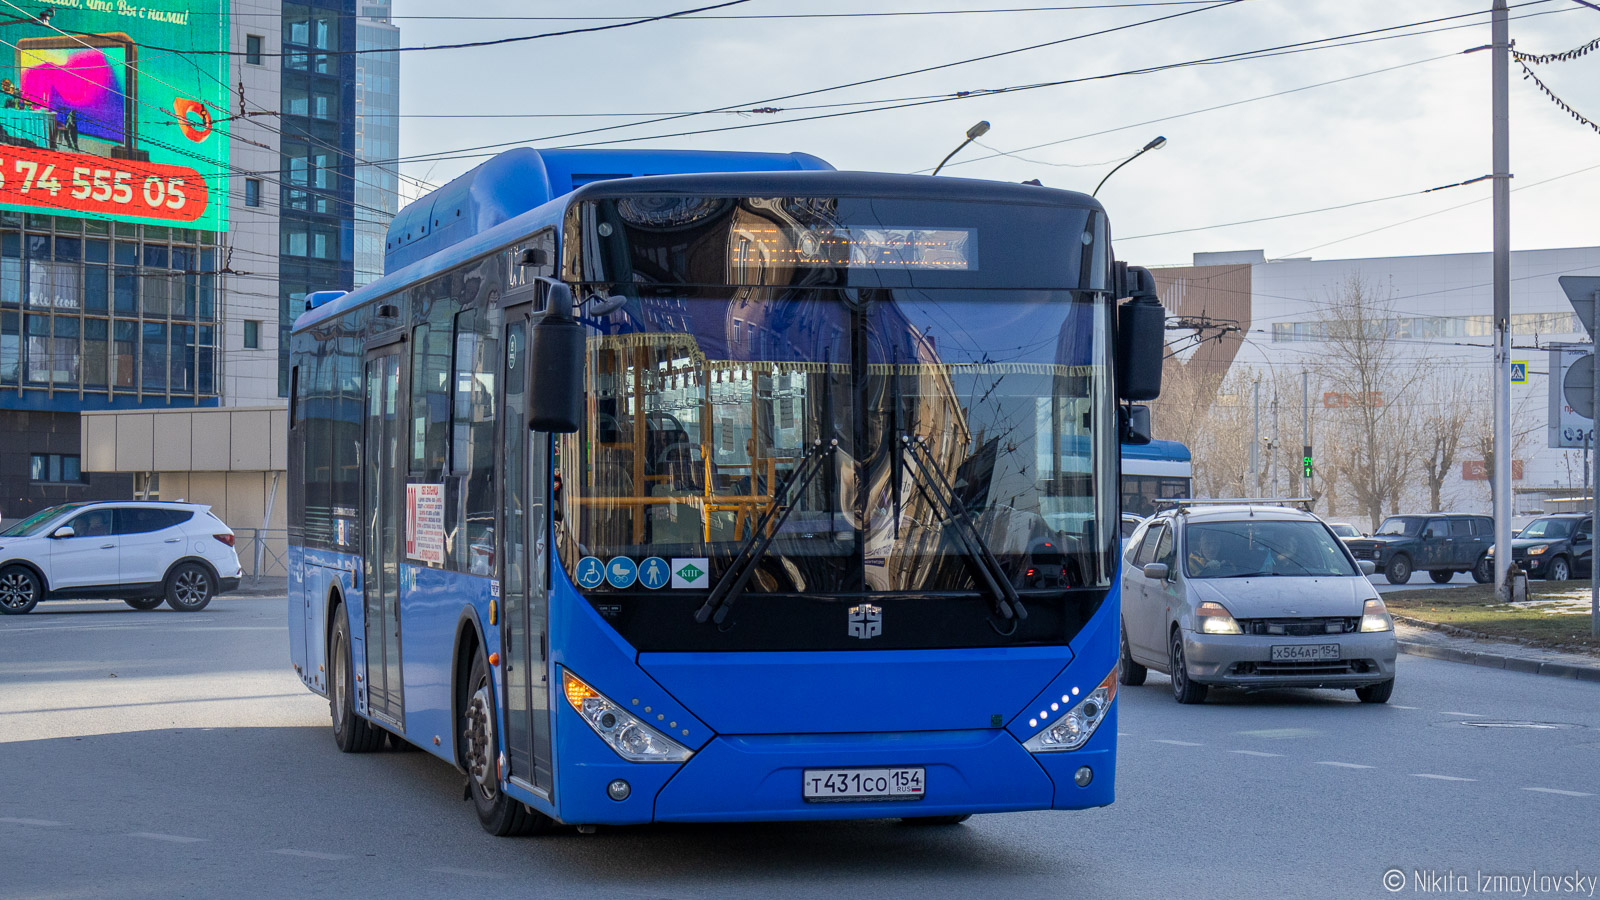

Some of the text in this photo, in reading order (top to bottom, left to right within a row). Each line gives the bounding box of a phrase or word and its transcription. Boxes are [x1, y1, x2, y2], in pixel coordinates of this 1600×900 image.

[147, 9, 189, 26] нами!
[15, 160, 62, 197] 74
[71, 167, 133, 204] 555
[143, 175, 185, 210] 05
[681, 568, 699, 578] КПГ
[1320, 645, 1338, 654] 154
[811, 770, 921, 794] Т431СО 154
